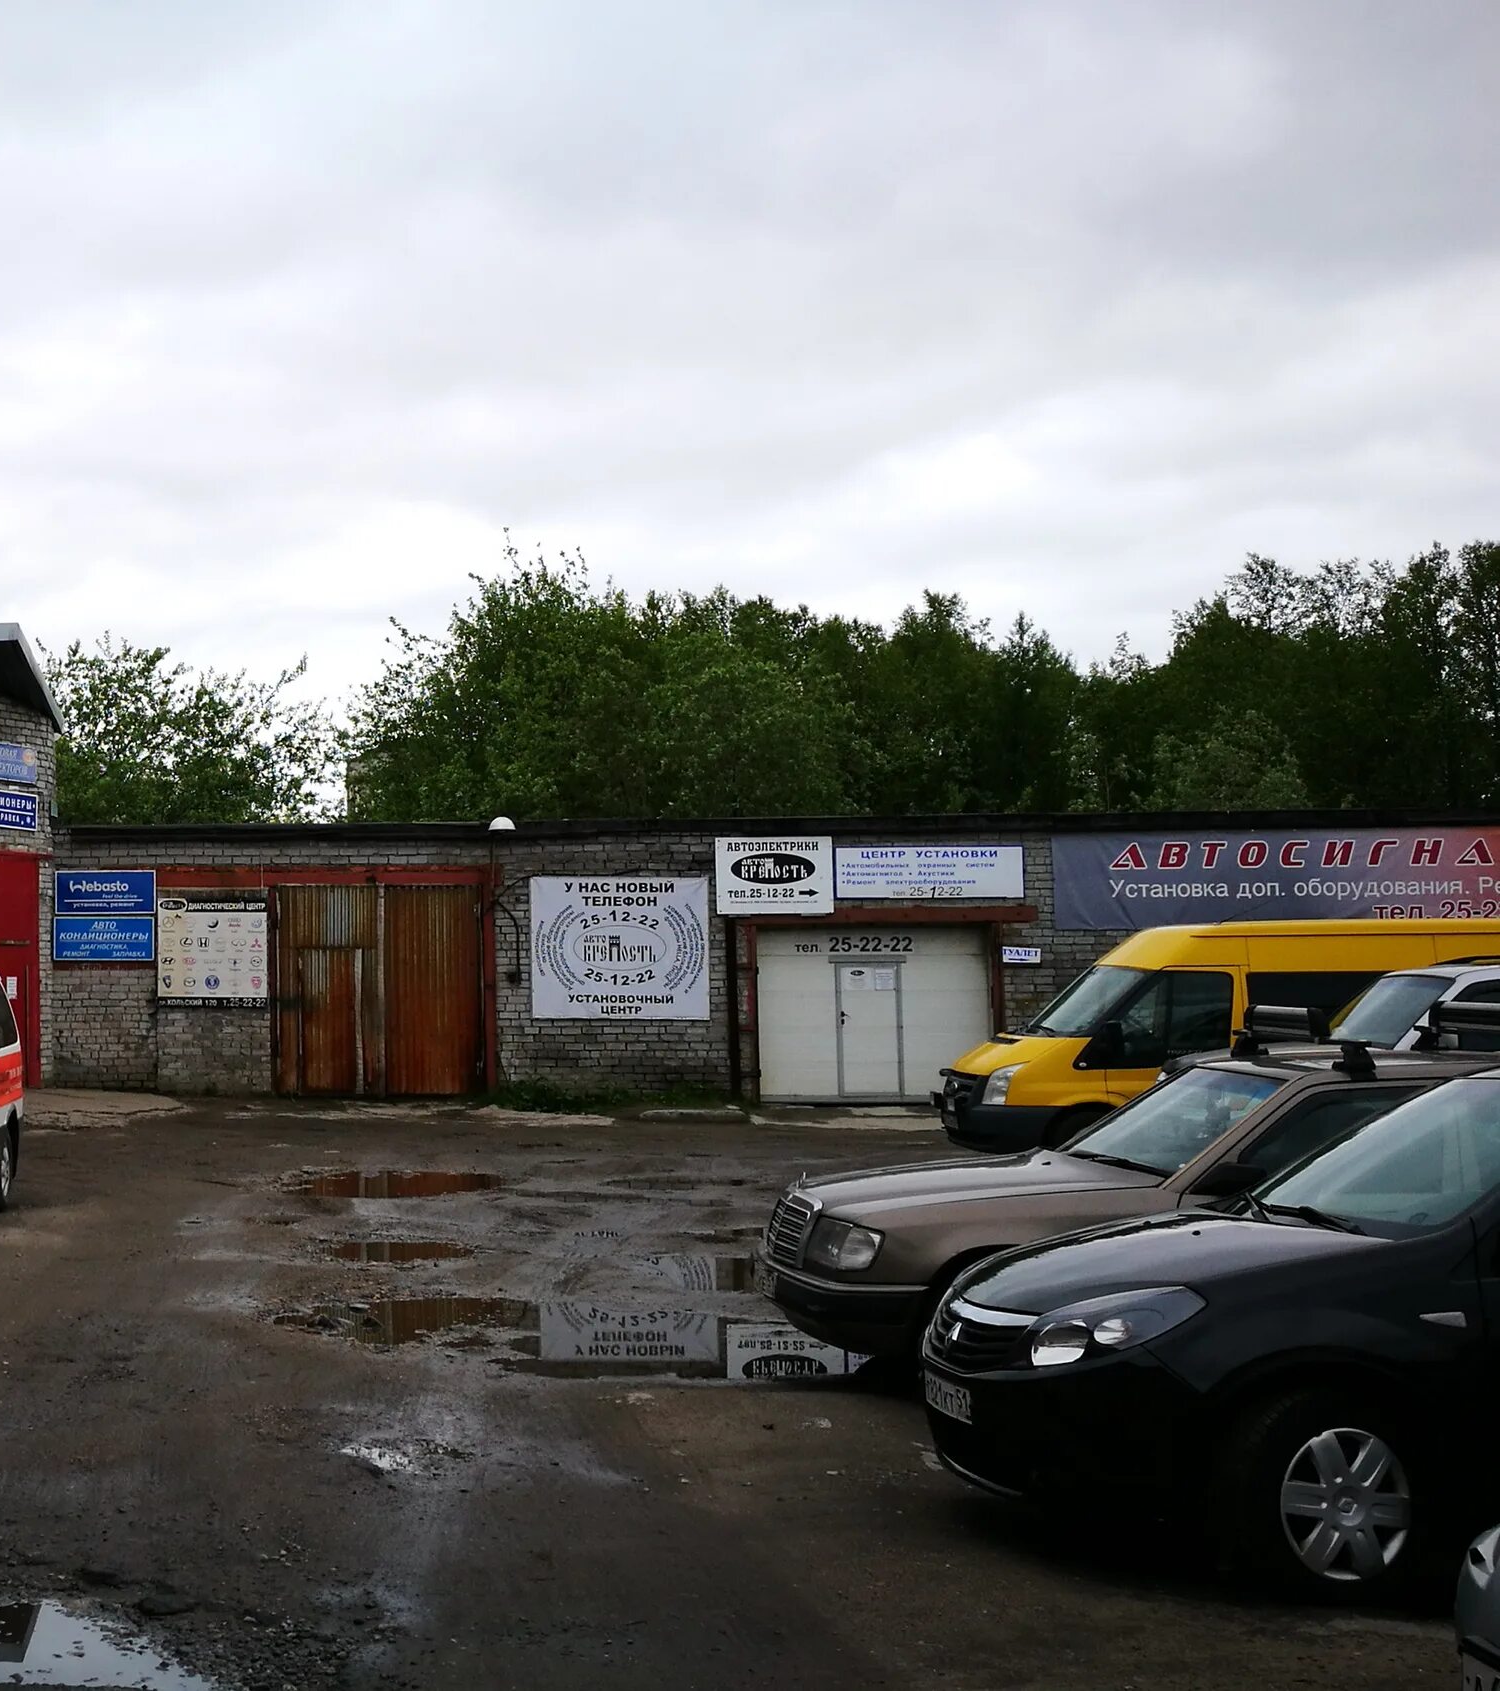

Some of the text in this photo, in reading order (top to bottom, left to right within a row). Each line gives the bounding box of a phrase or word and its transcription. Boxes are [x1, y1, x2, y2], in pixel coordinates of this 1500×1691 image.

[726, 841, 819, 852] АВТОЭЛЕКТРИКИ
[860, 849, 999, 860] ЦЕНТР УСТАНОВКИ
[1109, 837, 1495, 871] АВТОСИГНА
[741, 859, 808, 879] КРЕПОСТЬ
[69, 880, 129, 893] Webasto
[564, 880, 675, 893] У НАС НОВЫЙ
[885, 878, 976, 886] электрооборудования
[909, 885, 963, 898] 25-12-22
[1109, 879, 1229, 899] Установка
[1236, 881, 1286, 898] доп.
[1294, 878, 1471, 901] оборудования.
[188, 902, 245, 911] ДИАГНОСТИЧЕСКИЙ
[246, 902, 266, 911] ЦЕНТР
[582, 896, 658, 907] ТЕЛЕФОН
[1372, 899, 1500, 919] тел. 25-2
[91, 920, 117, 930] АВТО
[580, 910, 660, 930] 25-12-22
[59, 931, 149, 941] КОНДИЦИОНЕРЫ
[795, 936, 914, 953] тел. 25-22-22
[1003, 948, 1039, 957] ТУАЛЕТ
[584, 967, 656, 986] 25-12-22
[568, 993, 675, 1004] УСТАНОВОЧНЫЙ
[600, 1005, 642, 1016] ЦЕНТР
